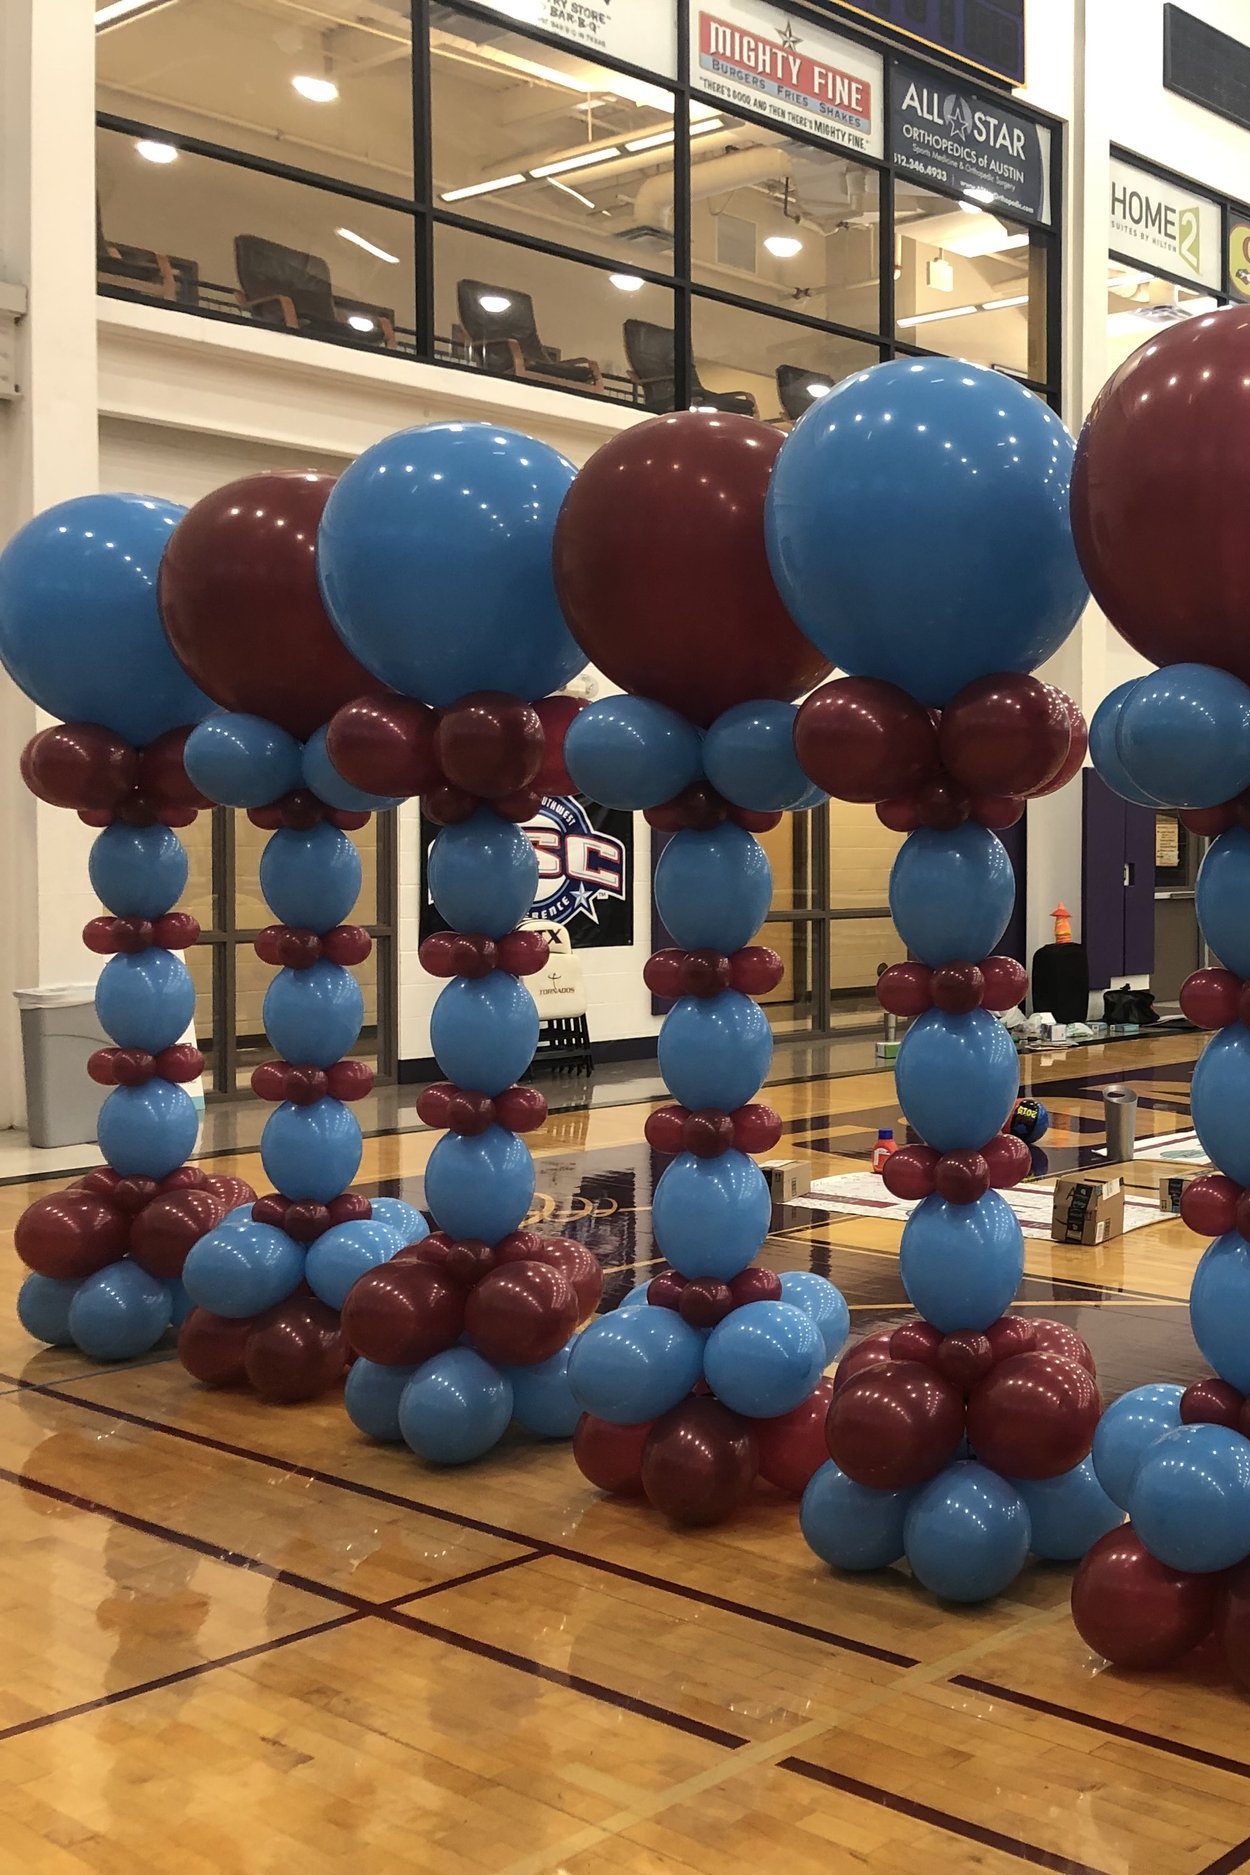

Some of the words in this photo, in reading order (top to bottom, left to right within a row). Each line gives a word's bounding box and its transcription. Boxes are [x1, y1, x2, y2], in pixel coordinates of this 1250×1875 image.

[710, 21, 802, 86] MIGHTY
[813, 65, 863, 112] FINE
[711, 58, 766, 90] BURGERS
[777, 85, 809, 107] FRIES
[819, 102, 861, 128] SHAKES
[753, 97, 767, 112] AND
[768, 103, 786, 119] THEN
[787, 110, 813, 130] THERE'S
[814, 119, 847, 143] MIGHTY
[901, 82, 944, 125] ALL
[973, 111, 1026, 161] STAR
[902, 124, 977, 163] ORTHOPEDICS
[978, 155, 988, 168] of
[989, 159, 1025, 184] AUSTIN
[958, 161, 965, 169] &
[1111, 181, 1177, 241] HOME
[1111, 220, 1137, 237] SUITES
[1140, 232, 1149, 241] BY
[1152, 238, 1177, 253] HILTON
[541, 796, 577, 826] UTHWEST
[522, 831, 620, 890] SC
[540, 986, 576, 996] TORNADOS
